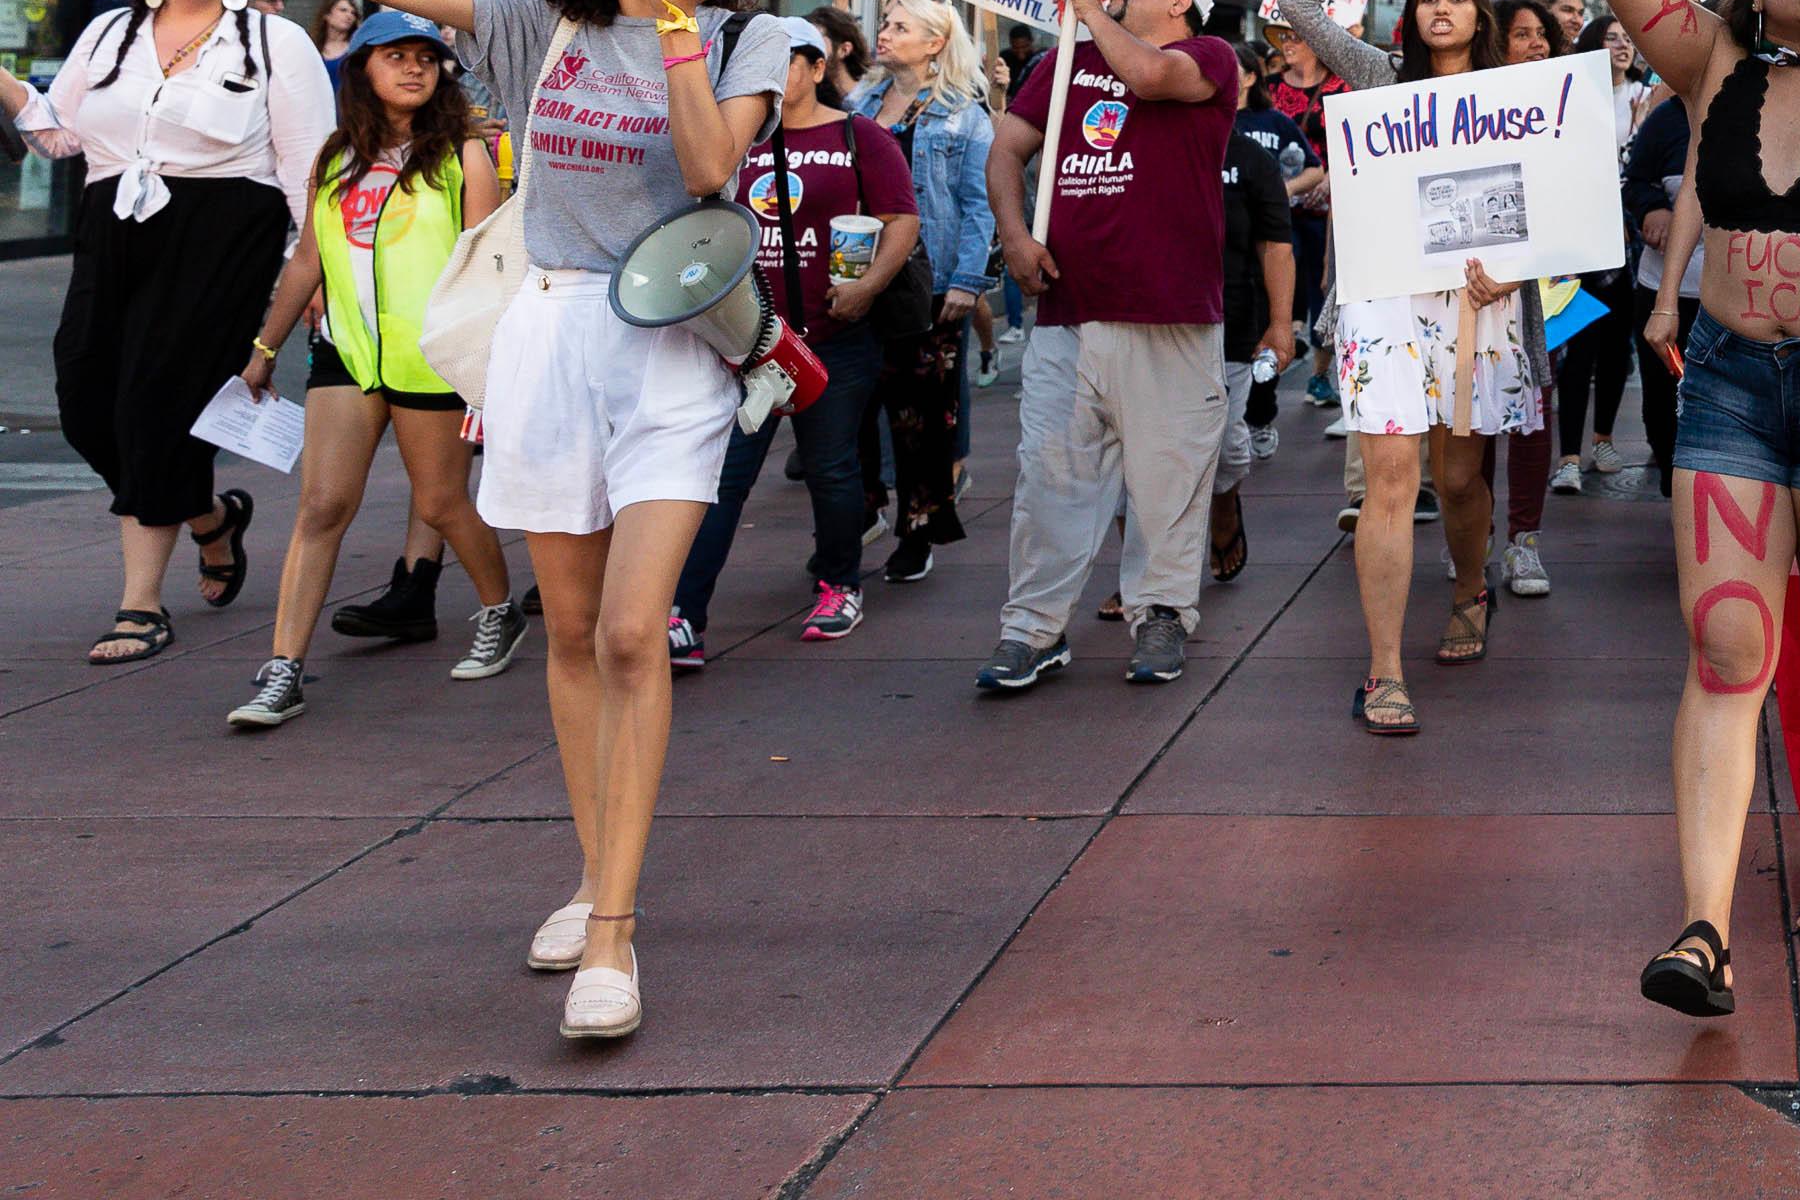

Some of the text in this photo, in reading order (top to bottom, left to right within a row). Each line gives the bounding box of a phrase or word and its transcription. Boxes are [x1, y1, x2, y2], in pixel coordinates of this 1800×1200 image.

[573, 80, 622, 97] Dream
[590, 69, 665, 91] California
[573, 108, 618, 130] ACT
[617, 115, 672, 136] NOW!
[581, 139, 646, 166] UNITY!
[1692, 471, 1776, 695] NO
